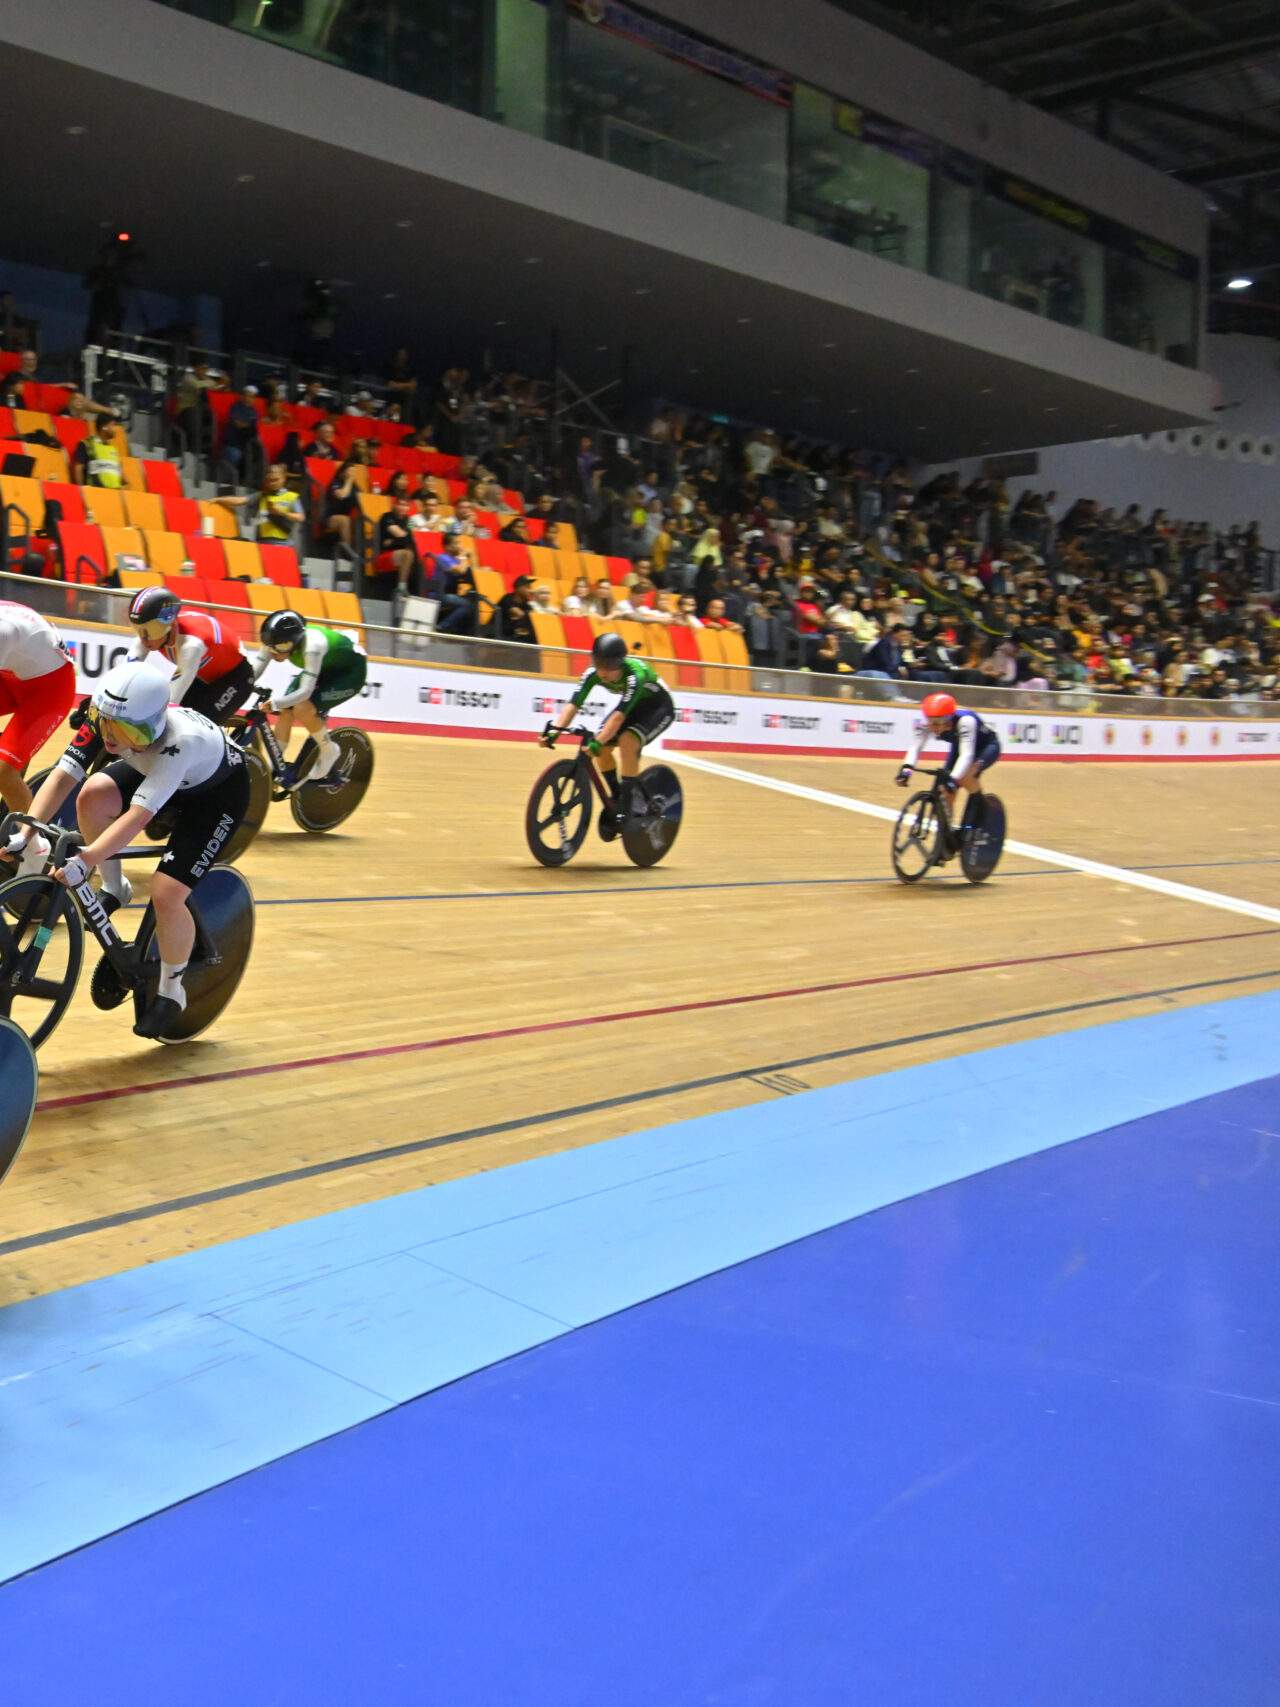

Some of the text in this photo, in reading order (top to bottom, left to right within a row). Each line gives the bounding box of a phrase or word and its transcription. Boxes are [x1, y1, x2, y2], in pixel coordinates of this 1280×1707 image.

[214, 686, 238, 711] NOR
[444, 688, 502, 711] TISSOT
[190, 812, 234, 879] EVIDEN
[75, 881, 121, 947] BMC
